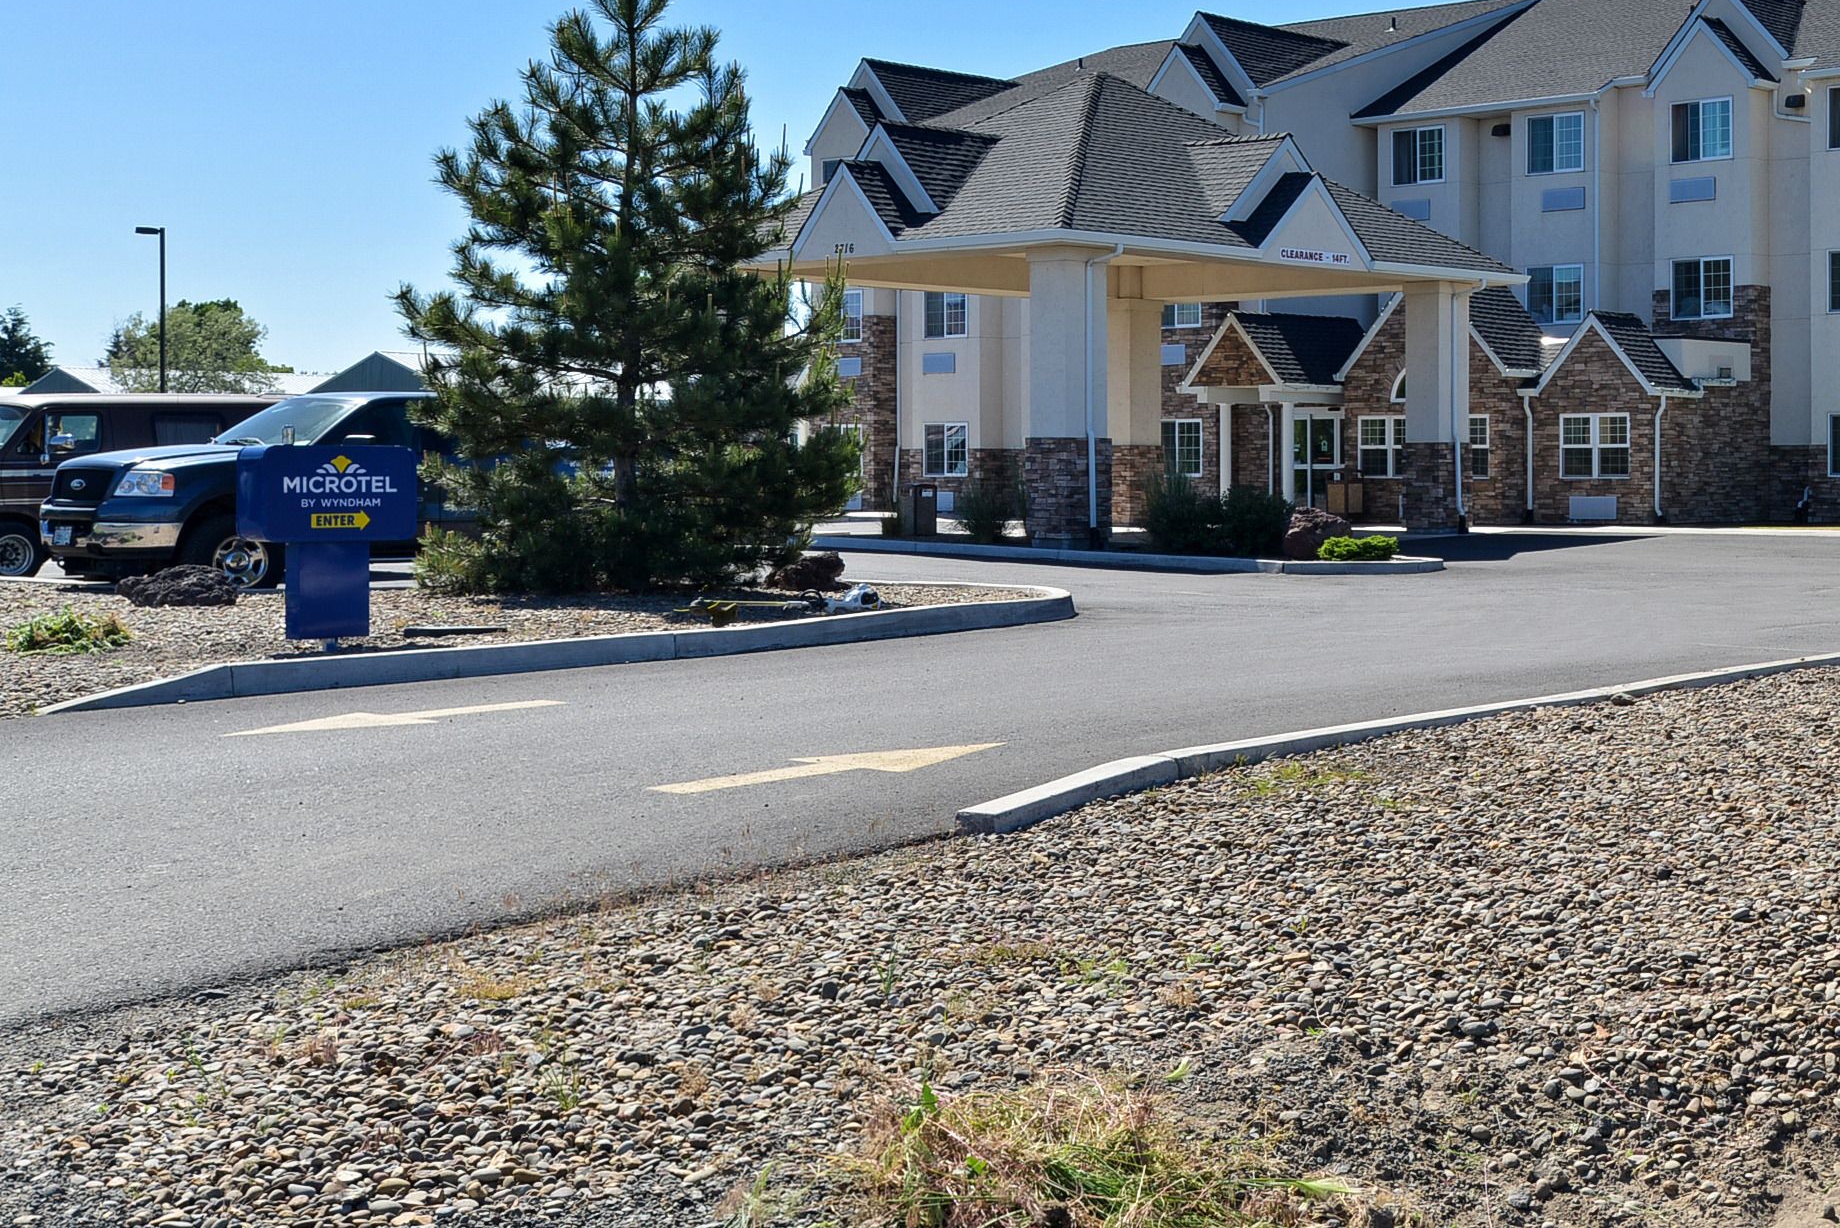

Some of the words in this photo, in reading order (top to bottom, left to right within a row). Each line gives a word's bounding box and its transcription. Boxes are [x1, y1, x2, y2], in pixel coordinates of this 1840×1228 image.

[1280, 248, 1323, 262] CLEARANCE
[283, 476, 398, 493] MICROTEL
[301, 498, 316, 508] BY
[320, 498, 381, 507] WYNDHAM
[316, 515, 355, 527] ENTER
